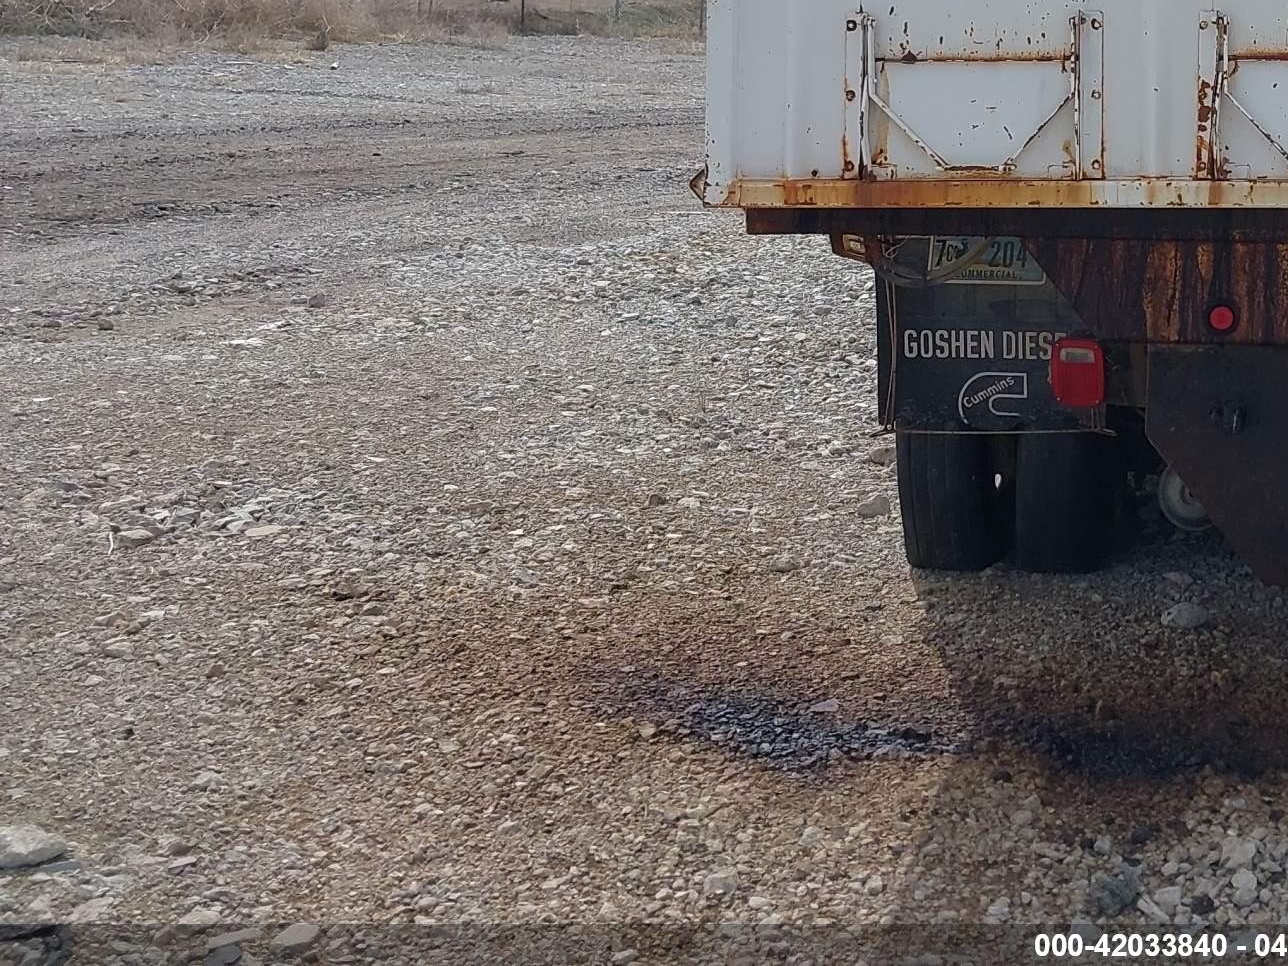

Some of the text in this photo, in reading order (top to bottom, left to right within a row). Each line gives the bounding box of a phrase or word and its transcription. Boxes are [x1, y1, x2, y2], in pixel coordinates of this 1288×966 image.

[958, 268, 1017, 279] OMMERCIAL
[904, 329, 1067, 360] GOSHEN DIES
[963, 376, 1015, 408] Cummins
